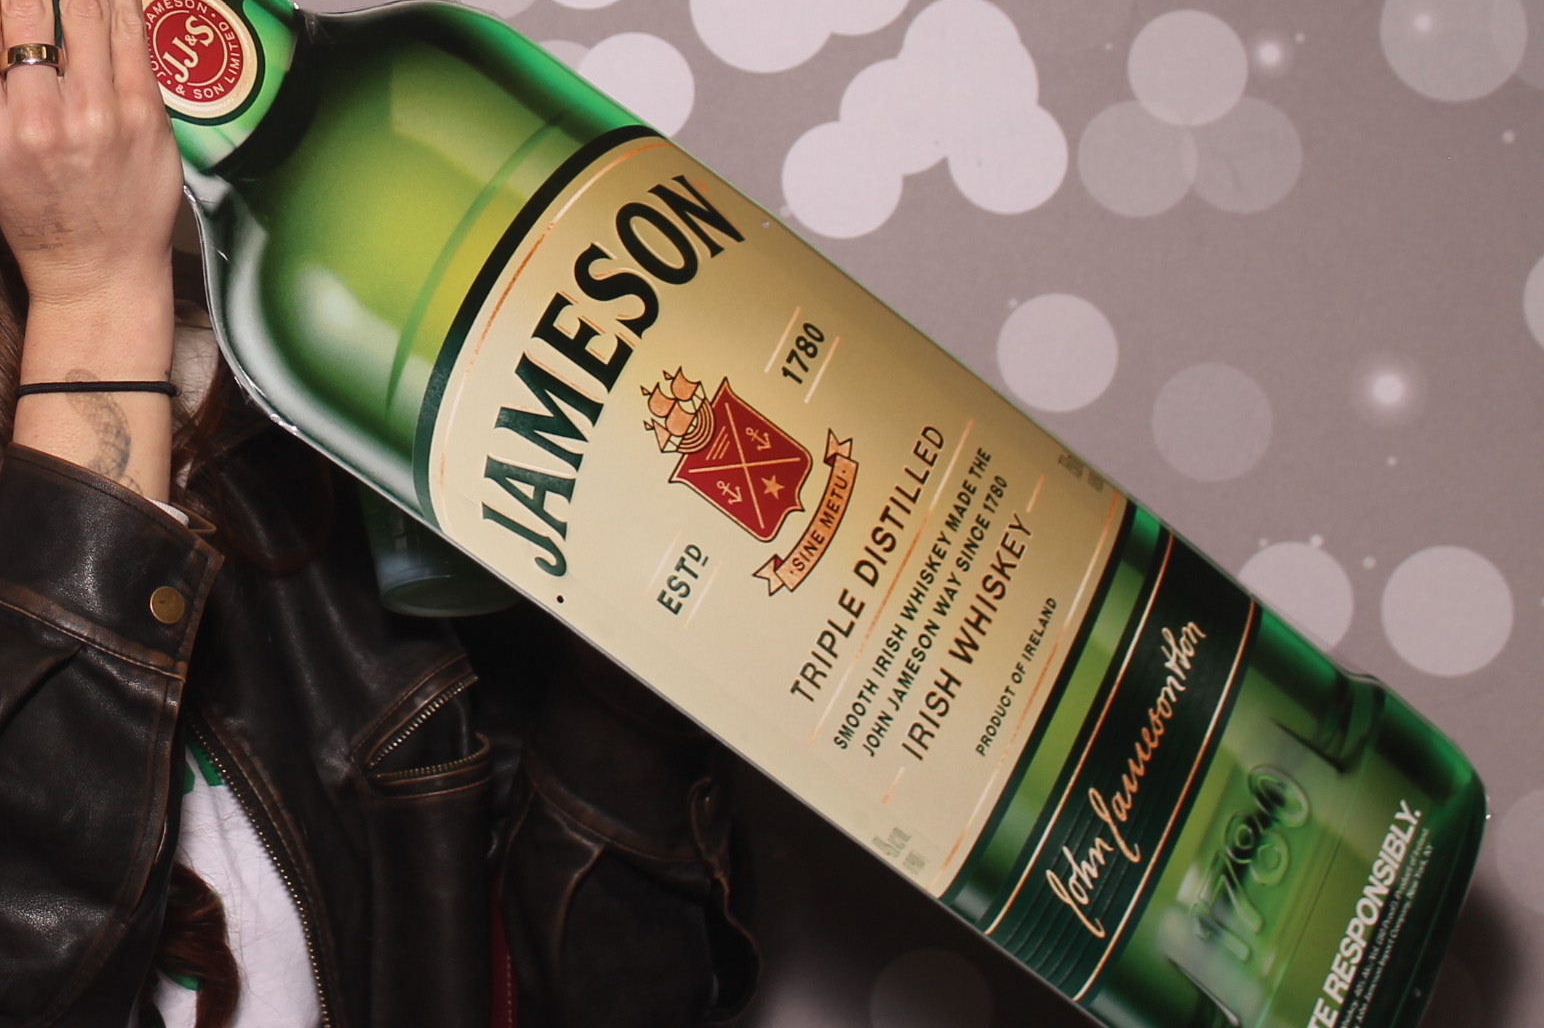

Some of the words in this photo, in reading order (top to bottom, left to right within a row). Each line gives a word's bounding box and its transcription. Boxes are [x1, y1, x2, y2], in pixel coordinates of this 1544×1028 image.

[162, 15, 215, 83] JJ&S
[175, 84, 186, 96] &
[193, 84, 225, 99] SON
[219, 21, 241, 84] LIMITED
[481, 175, 746, 577] JAMESON
[781, 322, 826, 385] 1780
[656, 544, 710, 615] ESTD
[790, 588, 866, 702] TRIPLE
[853, 425, 945, 588] DISTILLED
[792, 529, 826, 573] SINE
[821, 475, 849, 530] METU
[833, 678, 880, 750] SMOOTH
[872, 623, 908, 678] IRISH
[900, 531, 952, 621] WHISKEY
[945, 480, 977, 532] MADE
[968, 447, 991, 479] THE
[863, 710, 894, 757] JOHN
[887, 619, 941, 711] JAMESON
[933, 572, 962, 617] WAY
[956, 513, 991, 572] SINCE
[983, 475, 1008, 513] 1780
[901, 667, 962, 761] IRISH
[948, 512, 1033, 664] WHISKEY
[975, 686, 1016, 757] PRODUCT
[1011, 662, 1027, 685] OF
[1021, 597, 1057, 662] IRELAND
[1046, 837, 1115, 939] John
[1190, 764, 1311, 963] 1780
[1322, 799, 1422, 1005] RESPONSIBLY.
